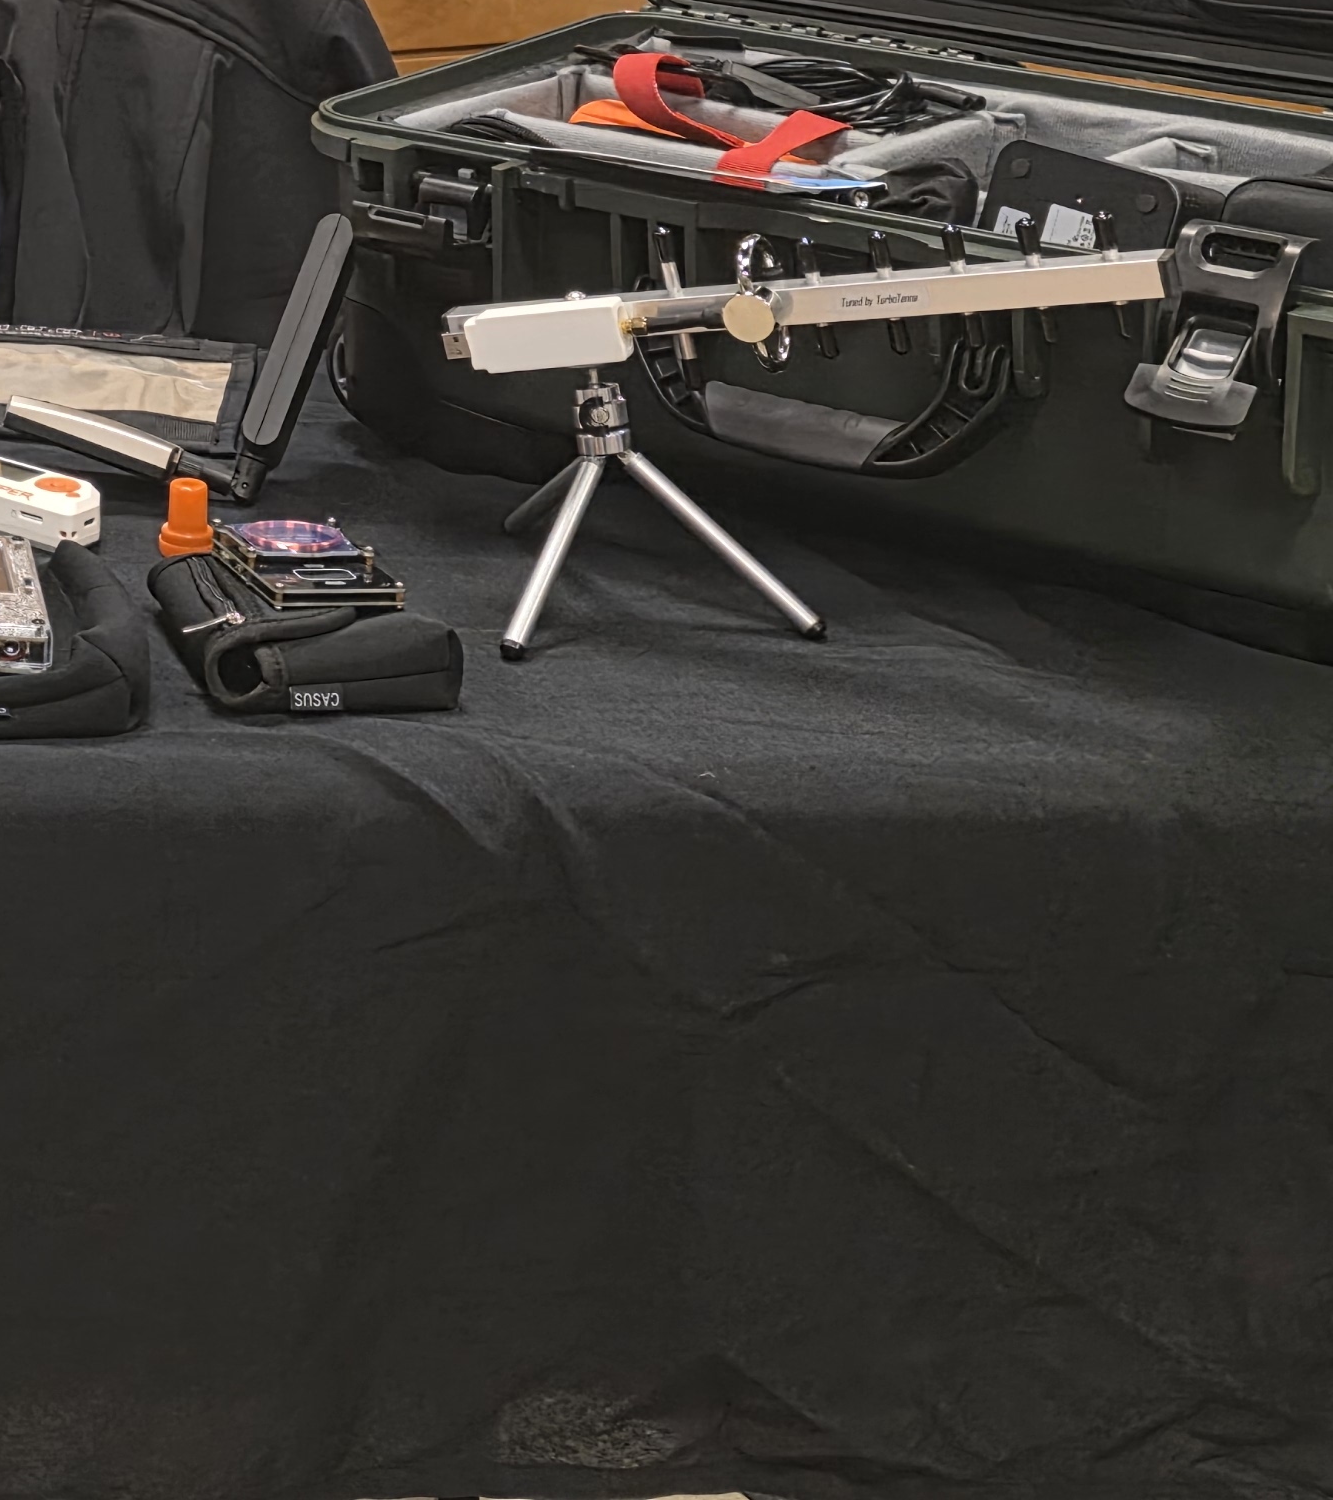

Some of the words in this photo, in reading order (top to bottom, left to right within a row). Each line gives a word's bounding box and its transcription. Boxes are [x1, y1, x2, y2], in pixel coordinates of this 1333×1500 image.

[841, 296, 863, 308] Tuned
[864, 296, 874, 307] by
[294, 692, 340, 707] CASUS
